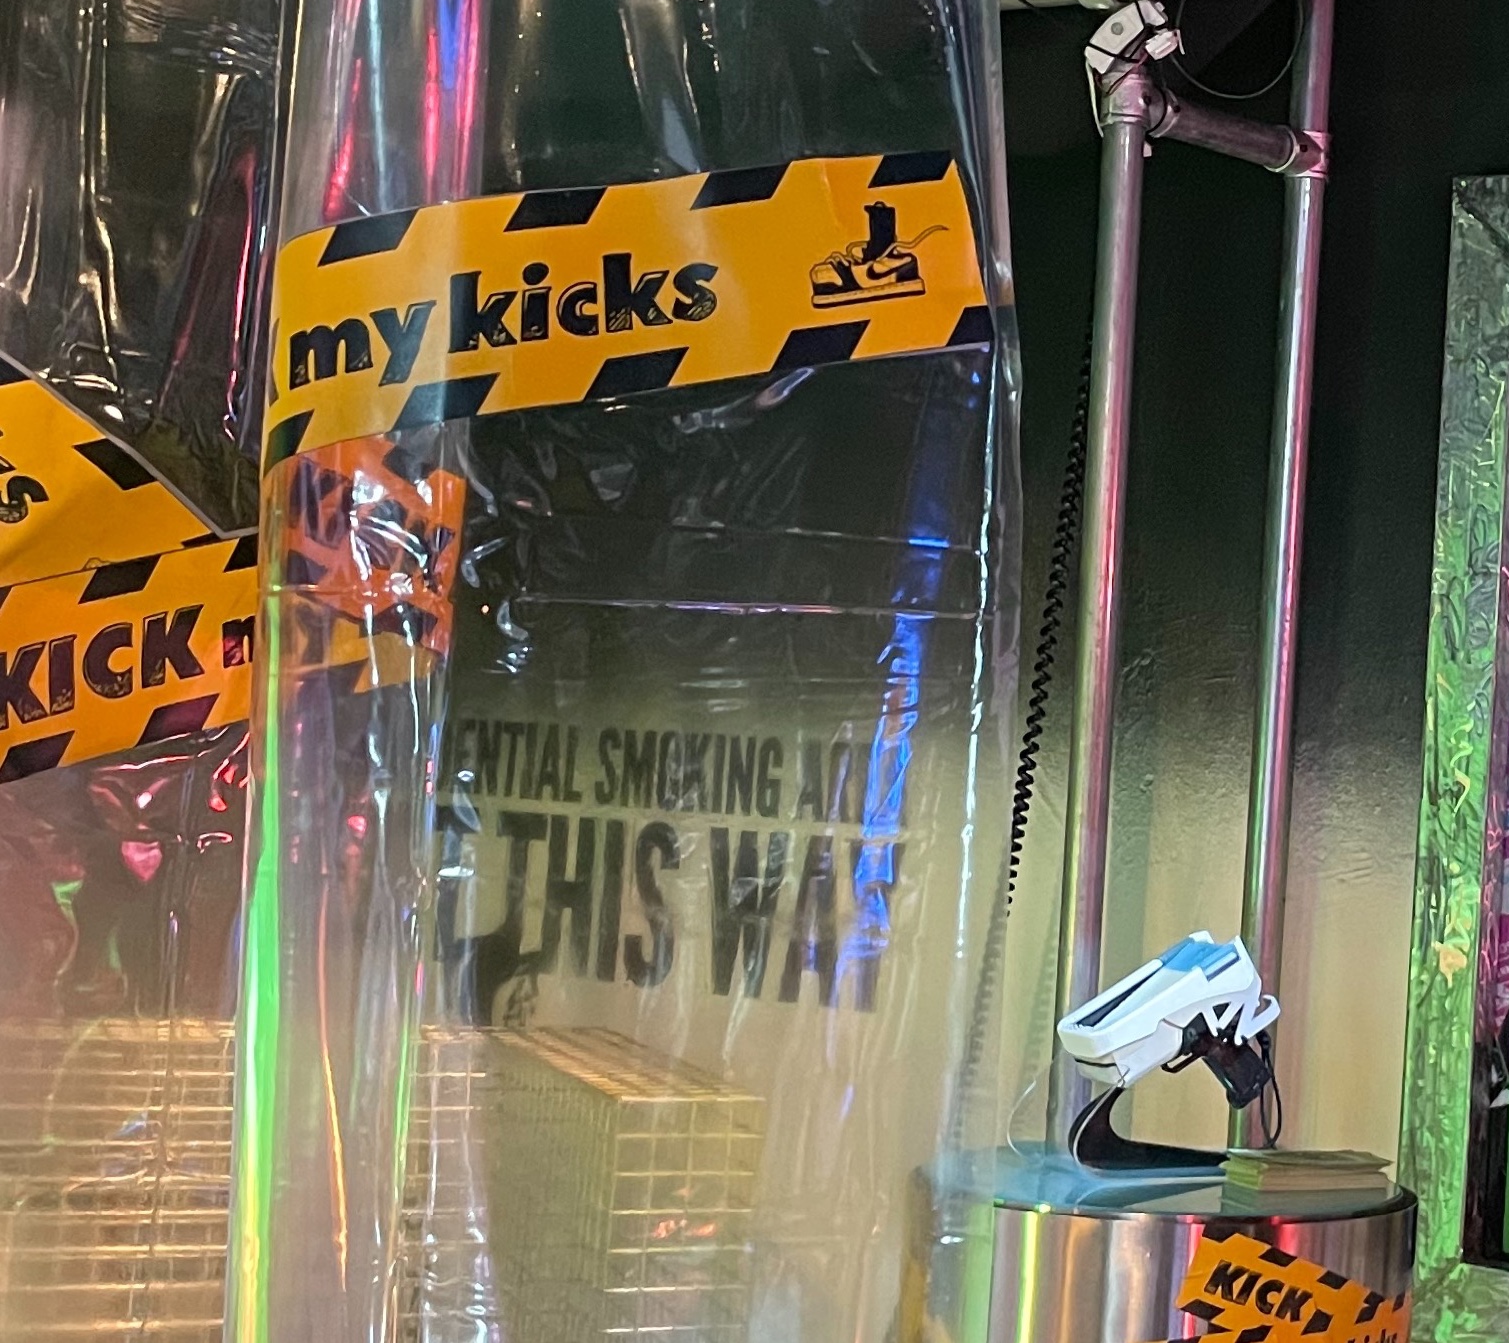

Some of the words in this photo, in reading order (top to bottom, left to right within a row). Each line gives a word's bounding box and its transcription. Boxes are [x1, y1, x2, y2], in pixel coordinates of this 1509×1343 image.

[289, 299, 437, 391] my
[448, 252, 719, 353] kicks
[0, 604, 205, 730] KICK
[594, 726, 785, 819] SMOKING
[497, 810, 681, 988] THIS
[1204, 1259, 1313, 1322] KICK
